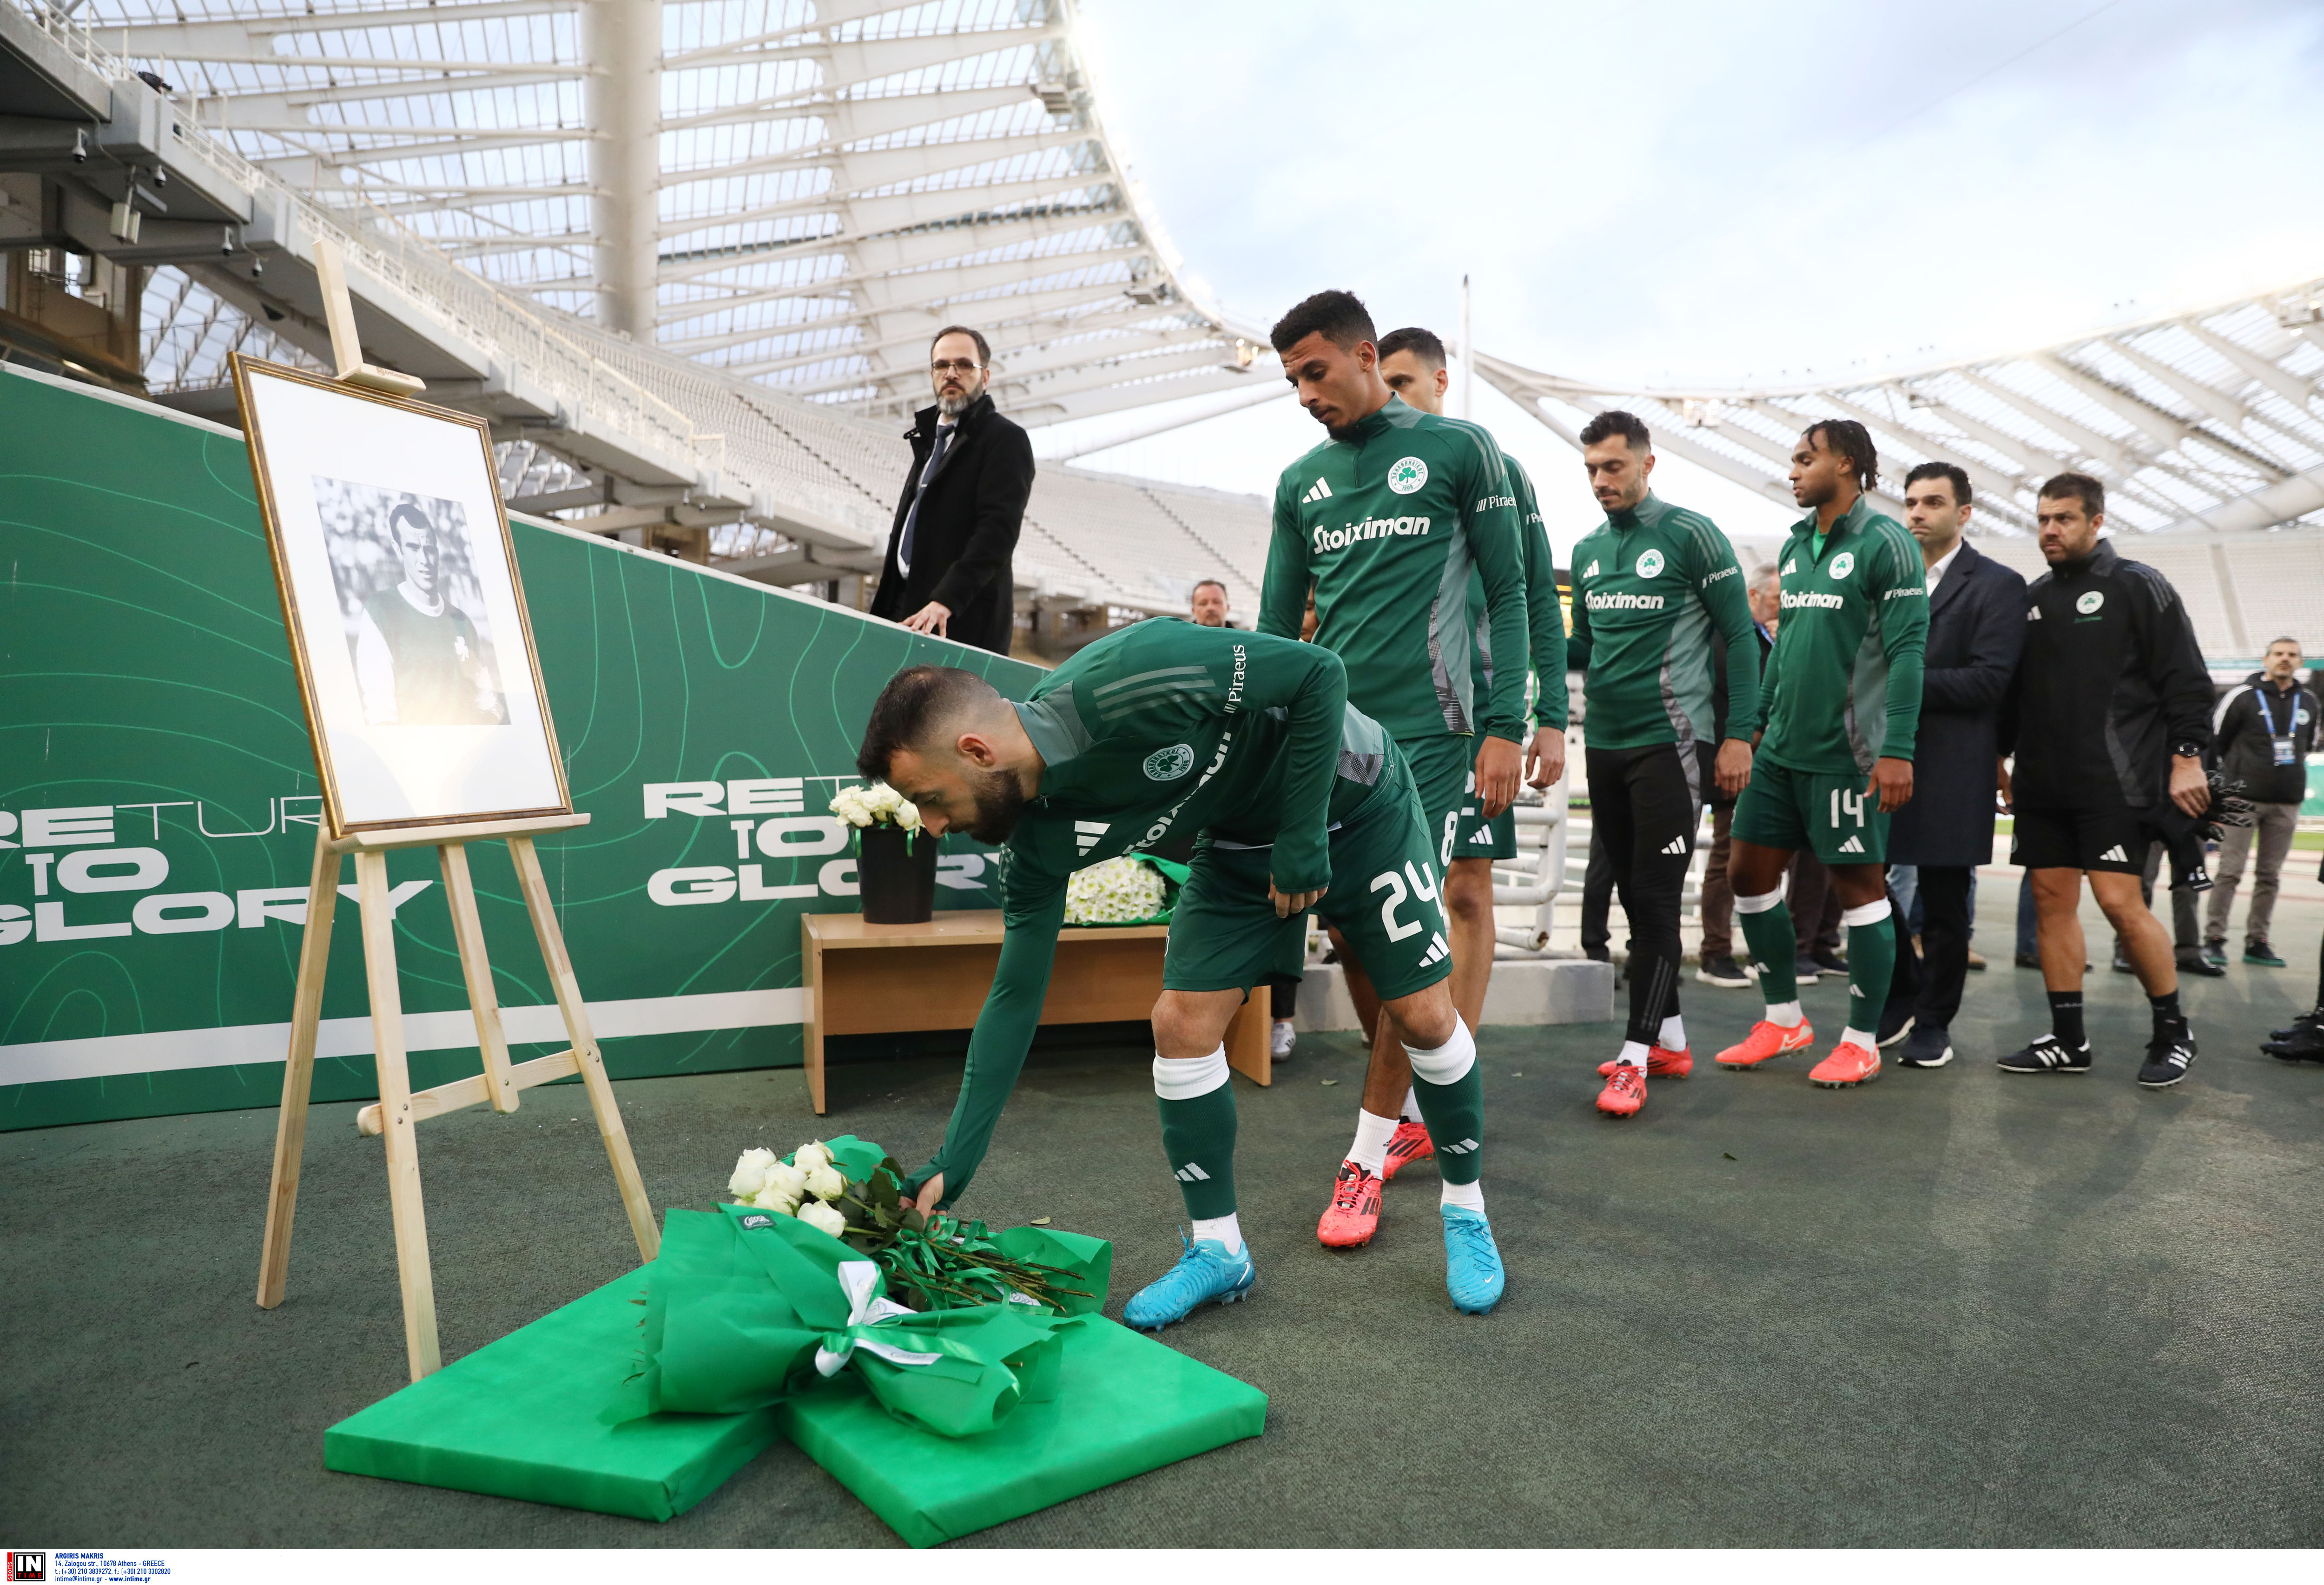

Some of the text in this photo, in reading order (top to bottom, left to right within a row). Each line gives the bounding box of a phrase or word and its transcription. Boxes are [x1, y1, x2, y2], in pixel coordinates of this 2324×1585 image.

[1488, 495, 1516, 509] Piraeu
[1313, 516, 1431, 555] Stoiximan
[1709, 566, 1738, 583] Piraeus
[1228, 645, 1247, 703] Piraeus
[1178, 760, 1189, 772] 1908
[1830, 788, 1865, 828] 14
[731, 816, 849, 859] TO
[1441, 811, 1459, 867] 8
[25, 847, 169, 896] TO
[0, 880, 434, 945] LORY
[1370, 860, 1444, 943] 24
